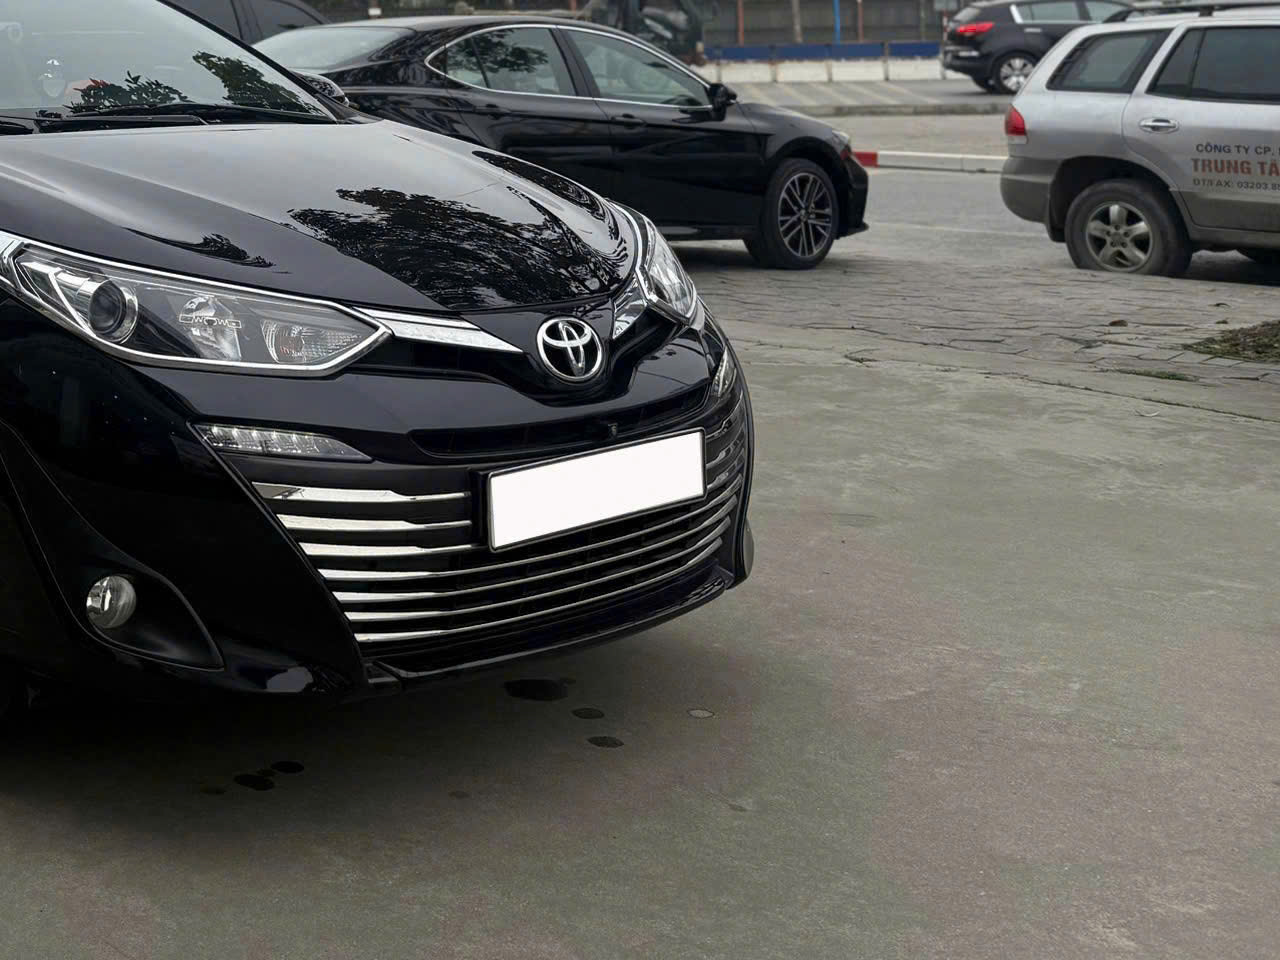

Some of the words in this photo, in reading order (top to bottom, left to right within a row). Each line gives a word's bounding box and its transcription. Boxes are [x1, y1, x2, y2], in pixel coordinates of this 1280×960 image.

[1196, 142, 1231, 154] CÔNG
[1234, 144, 1250, 154] TY
[1191, 158, 1252, 176] TRUNG
